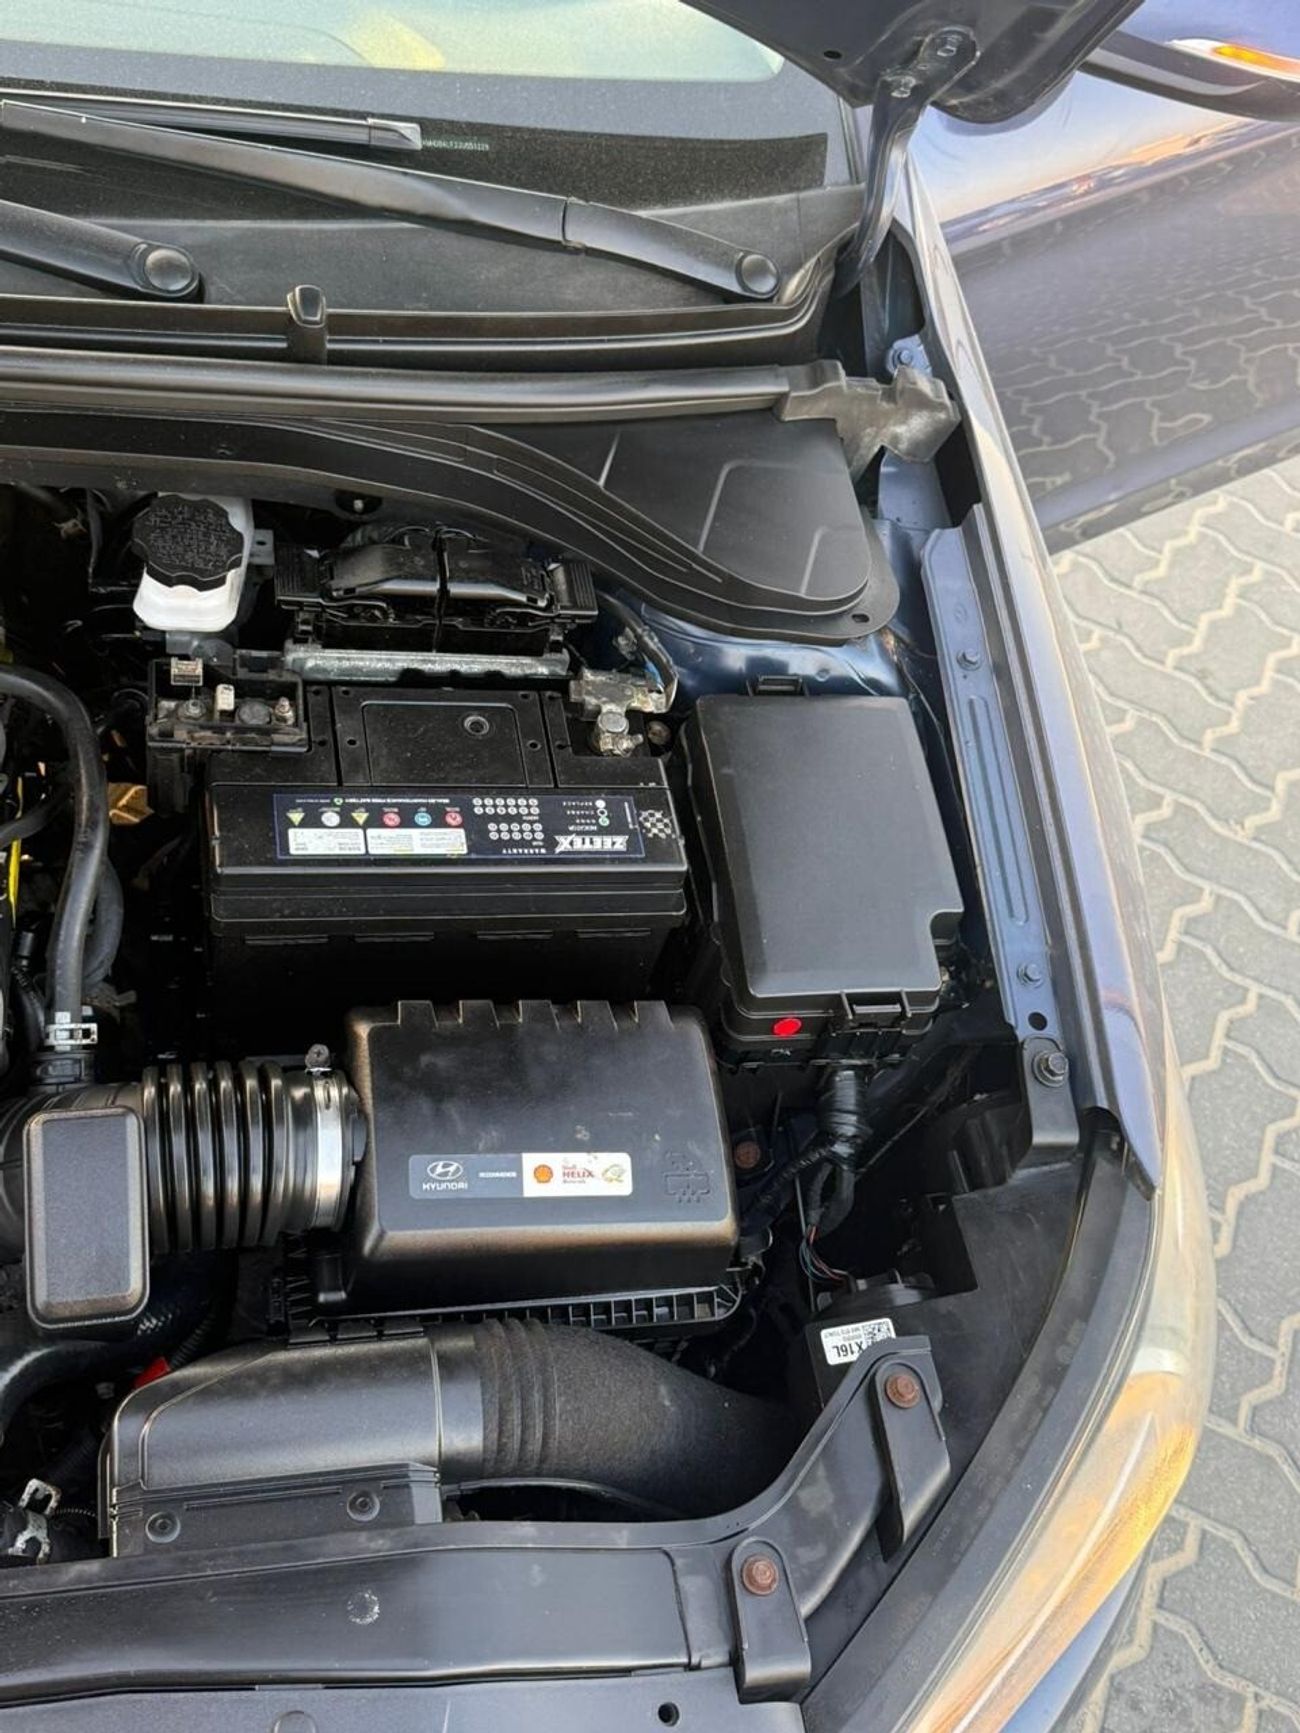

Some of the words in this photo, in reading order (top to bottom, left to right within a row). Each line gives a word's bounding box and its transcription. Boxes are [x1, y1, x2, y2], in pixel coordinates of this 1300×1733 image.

[554, 834, 629, 854] ZEETEX
[562, 1168, 595, 1178] HELIX
[423, 1182, 468, 1191] HYUNDAI
